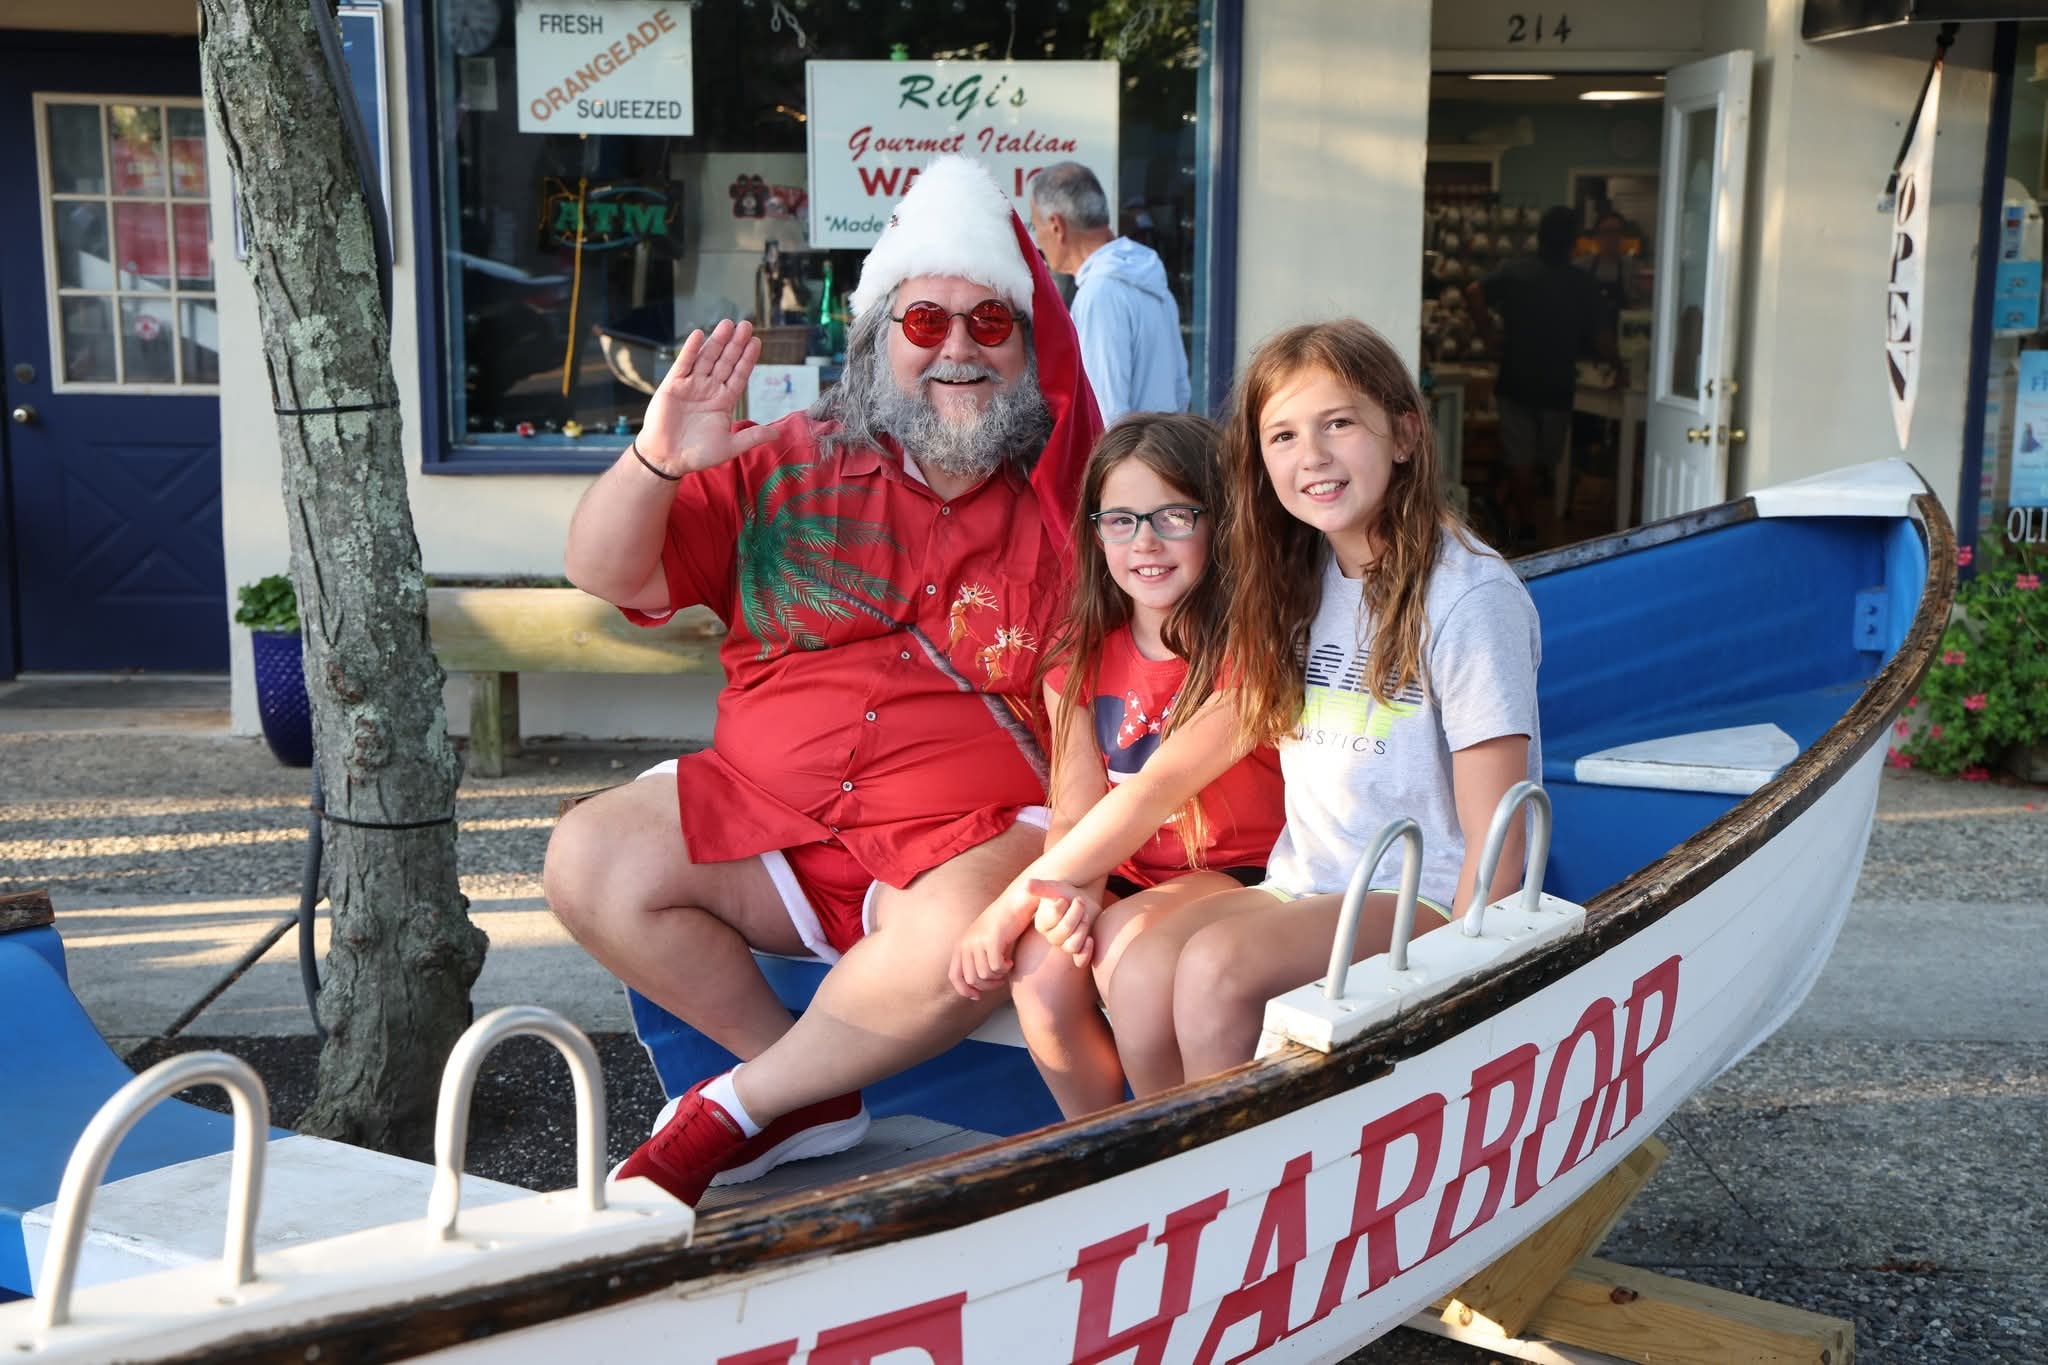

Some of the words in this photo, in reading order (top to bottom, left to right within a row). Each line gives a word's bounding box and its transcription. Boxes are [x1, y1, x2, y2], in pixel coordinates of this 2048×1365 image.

[539, 14, 603, 35] FRESH
[1507, 13, 1572, 44] 214
[530, 8, 677, 121] ORANGEADE
[577, 99, 682, 119] SQUEEZED
[849, 126, 965, 161] Gourmet
[977, 127, 1077, 153] Italian
[555, 202, 668, 235] ATM
[1886, 174, 1917, 401] OPEN
[1068, 954, 1683, 1365] HARBOR
